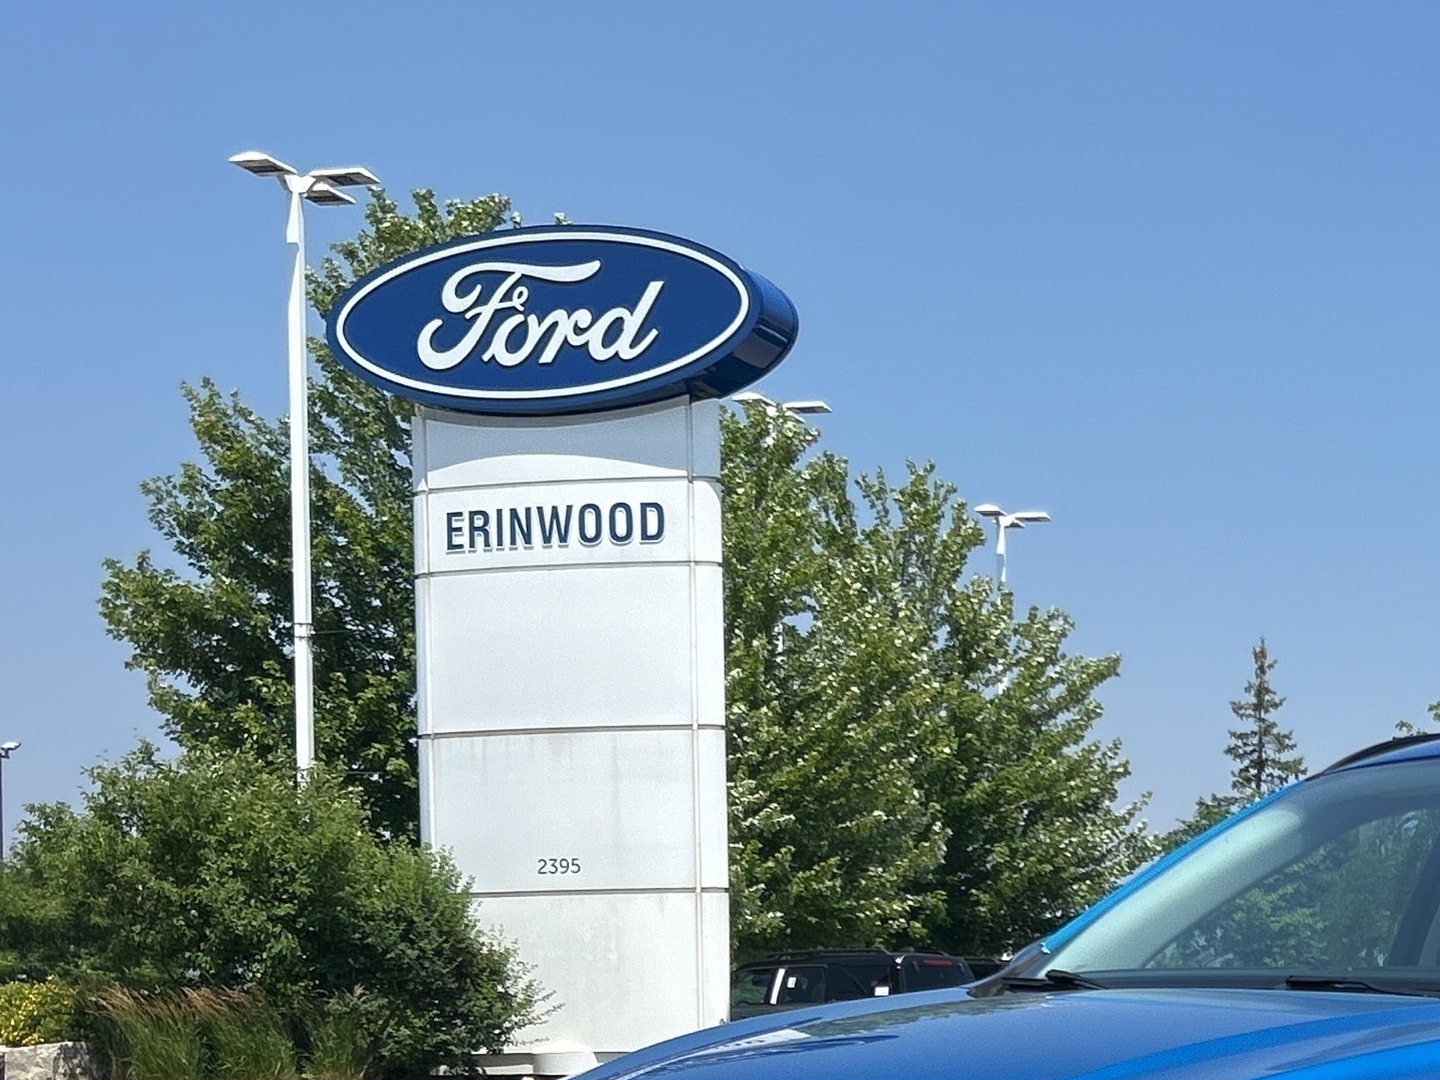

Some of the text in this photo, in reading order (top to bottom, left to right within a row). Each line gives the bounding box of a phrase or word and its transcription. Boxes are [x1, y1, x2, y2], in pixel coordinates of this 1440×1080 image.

[417, 260, 664, 371] Ford
[446, 502, 665, 554] ERINWOOD
[537, 858, 582, 876] 2395
